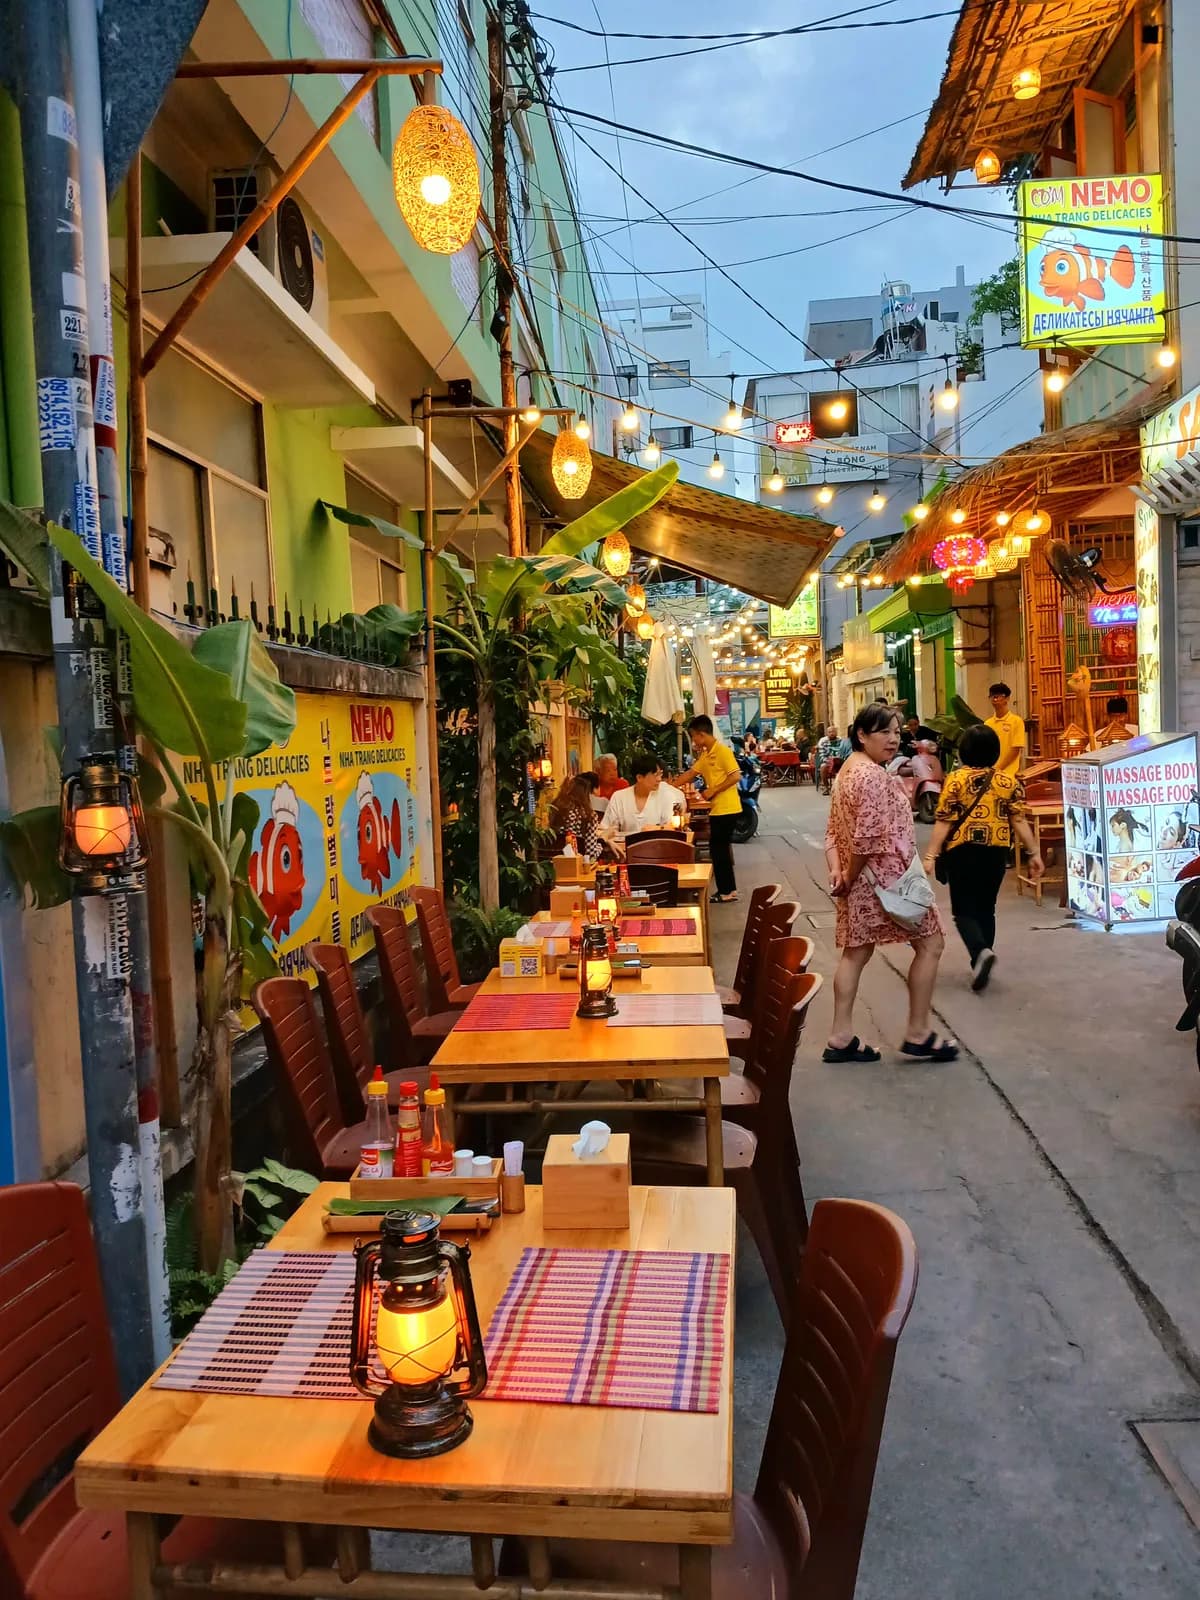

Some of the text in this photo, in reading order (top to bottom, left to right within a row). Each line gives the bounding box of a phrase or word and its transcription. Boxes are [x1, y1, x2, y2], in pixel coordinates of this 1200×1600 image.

[1071, 178, 1152, 207] NEMO
[1056, 211, 1090, 223] TRANG
[1092, 207, 1152, 220] DELICACIES
[1033, 307, 1156, 336] ДЕЛИКАТЕСЫ НЯЧАНГА
[350, 704, 394, 744] NEMO
[184, 761, 206, 784] NH
[256, 754, 310, 776] DELICACIES
[339, 748, 406, 768] NHA TRANG DELICACIES
[1103, 764, 1162, 785] MASSAGE
[1164, 762, 1197, 781] BODY
[1106, 786, 1164, 807] MASSAGE
